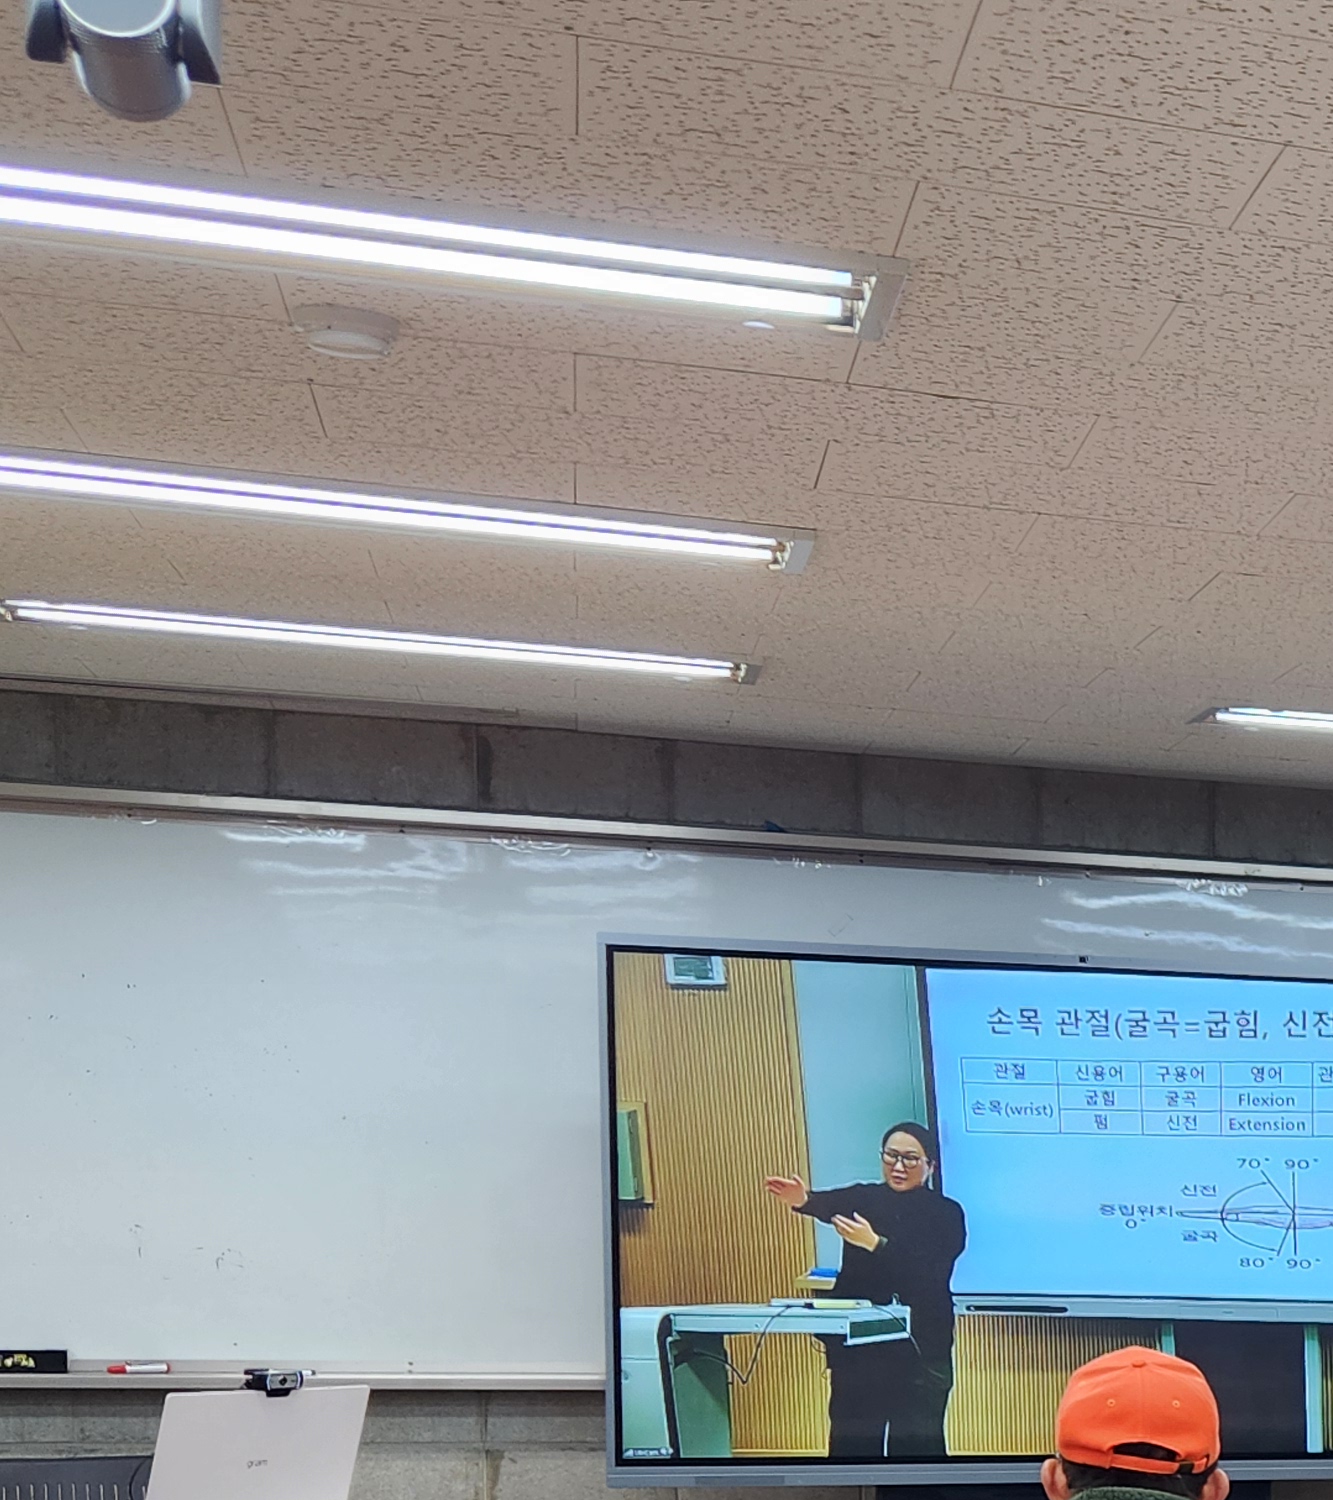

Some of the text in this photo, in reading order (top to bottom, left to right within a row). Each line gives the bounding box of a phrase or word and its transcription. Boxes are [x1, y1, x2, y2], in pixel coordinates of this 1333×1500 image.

[986, 1006, 1043, 1037] 손목
[993, 1062, 1026, 1081] 관절
[1074, 1065, 1124, 1082] 신용어
[1156, 1065, 1206, 1083] 구용어
[1250, 1066, 1283, 1084] 영어
[1165, 1090, 1198, 1108] 굴곡
[1238, 1092, 1296, 1108] Flexion
[970, 1099, 1054, 1119] 손목(wrist)
[1166, 1114, 1198, 1132] 신전
[1228, 1116, 1306, 1132] Extension
[246, 1459, 268, 1469] gram
